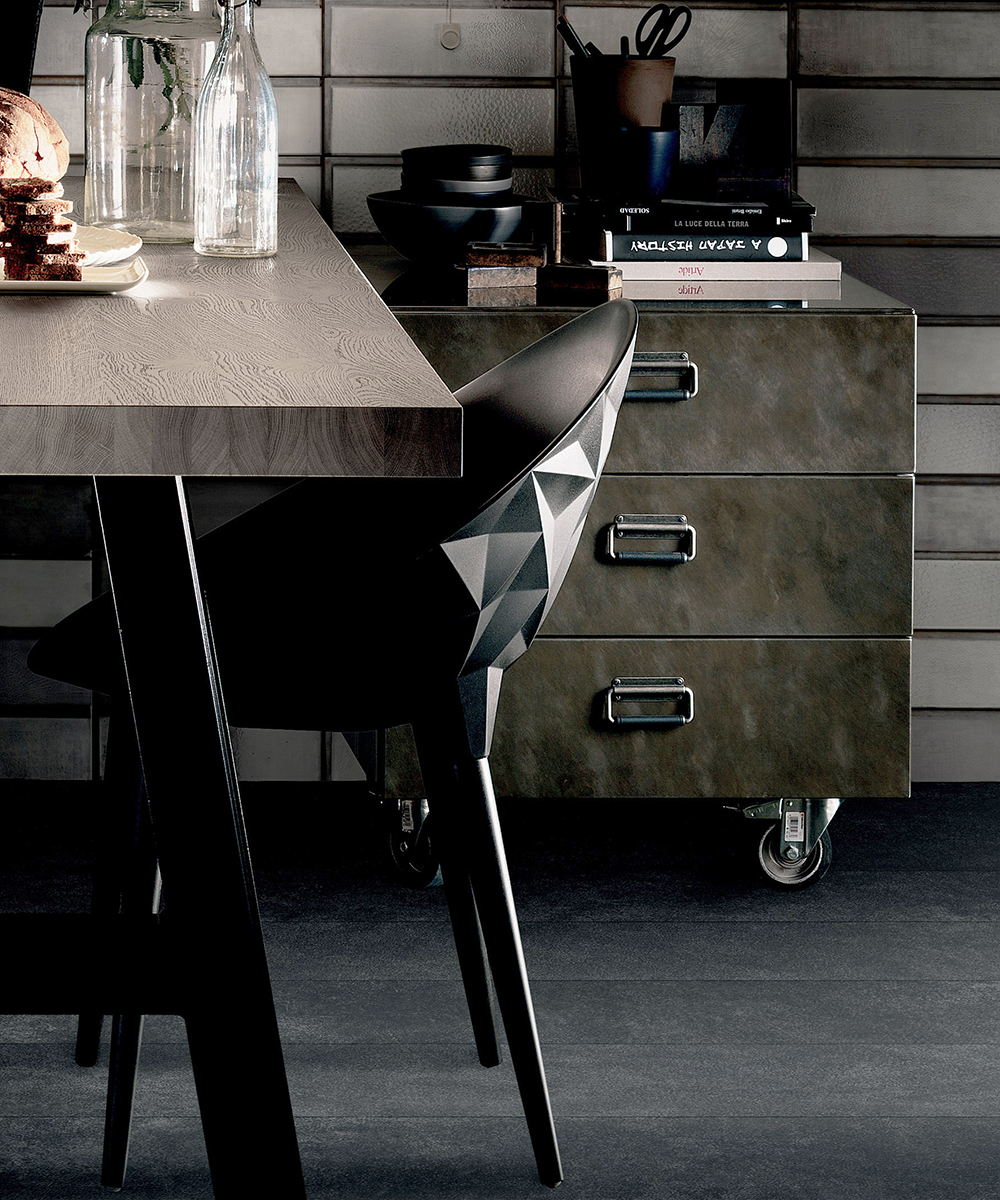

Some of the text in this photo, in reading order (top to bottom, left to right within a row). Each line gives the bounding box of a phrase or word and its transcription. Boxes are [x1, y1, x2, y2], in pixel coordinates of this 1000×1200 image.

[704, 220, 726, 228] DELLA
[727, 220, 750, 228] TERRA
[630, 239, 762, 252] A JAPAN HISTORY
